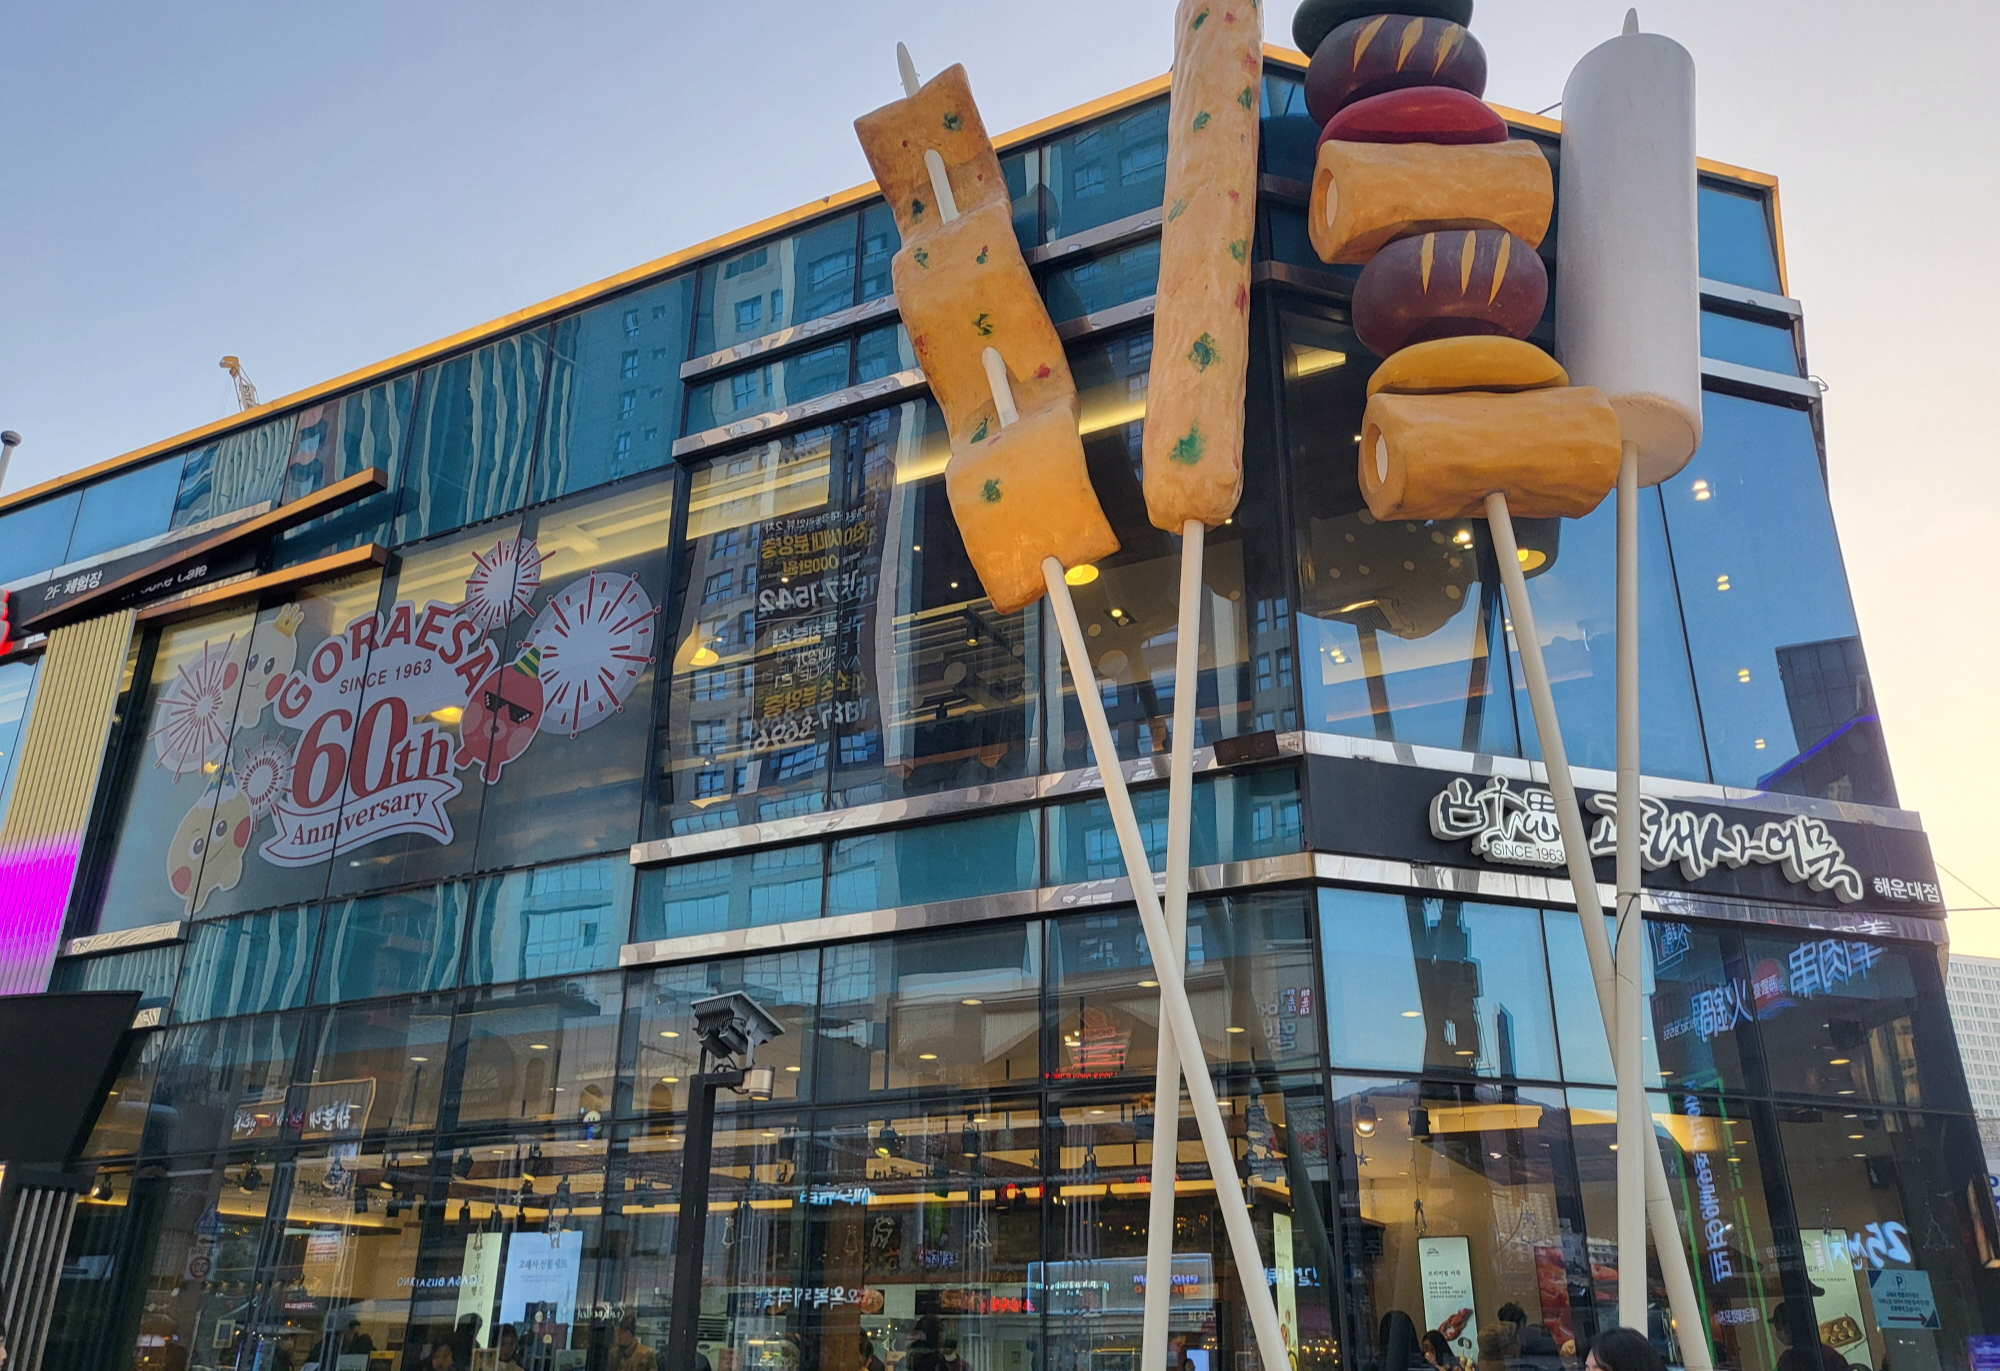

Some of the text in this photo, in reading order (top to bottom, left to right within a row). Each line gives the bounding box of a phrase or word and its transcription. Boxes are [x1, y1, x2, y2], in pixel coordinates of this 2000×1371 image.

[44, 569, 104, 602] 2F 체험장
[276, 603, 499, 719] GORAESA
[339, 658, 433, 695] SINCE 1963
[291, 696, 450, 810] 60th
[290, 789, 429, 846] Anniversary
[1493, 843, 1565, 862] SINCE 1963
[1873, 877, 1941, 904] 해운대점
[1895, 1276, 1904, 1288] P
